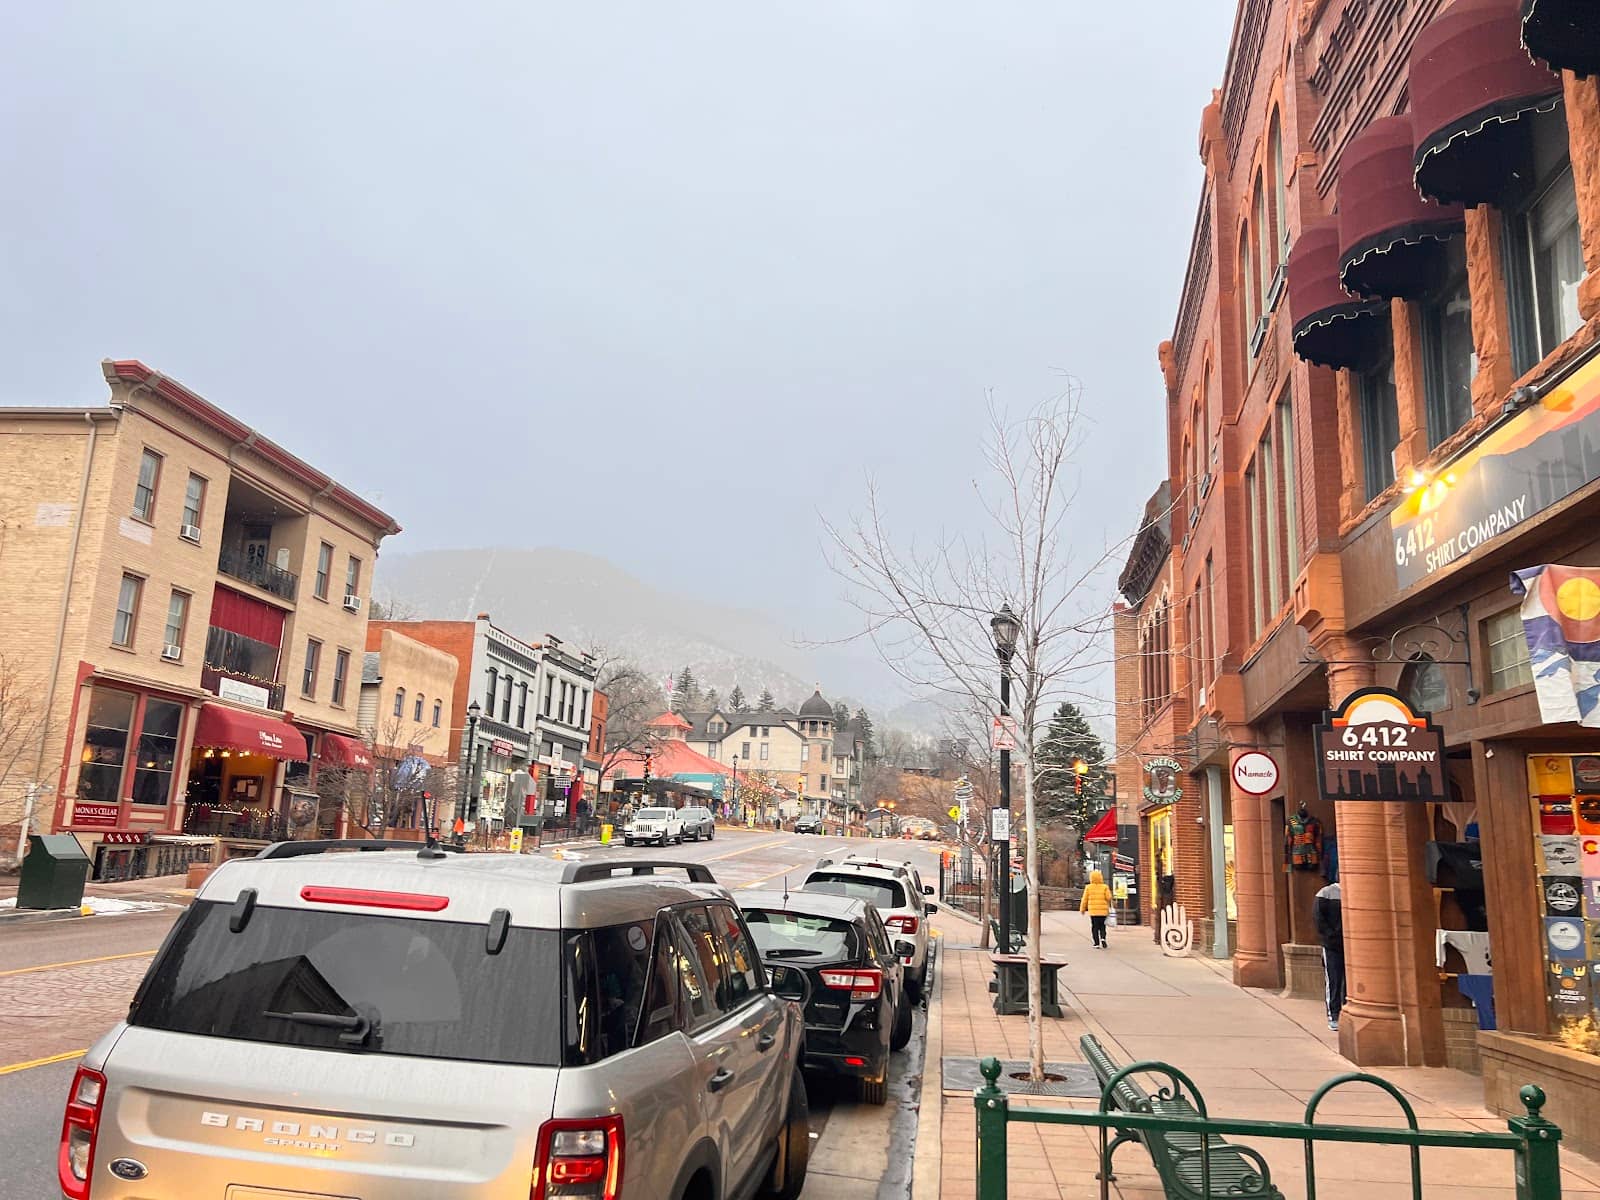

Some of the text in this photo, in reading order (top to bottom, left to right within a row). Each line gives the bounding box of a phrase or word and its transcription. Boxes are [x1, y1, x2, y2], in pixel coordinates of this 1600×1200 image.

[1425, 494, 1526, 574] SHIRT COMPANY
[1341, 726, 1417, 750] 6,412'
[1326, 750, 1436, 762] SHIRT COMPANY
[1143, 758, 1183, 773] BAREFOOT
[75, 806, 118, 816] MONA'S CELLAR
[200, 1111, 415, 1147] BRONCO
[263, 1137, 343, 1151] SPORT
